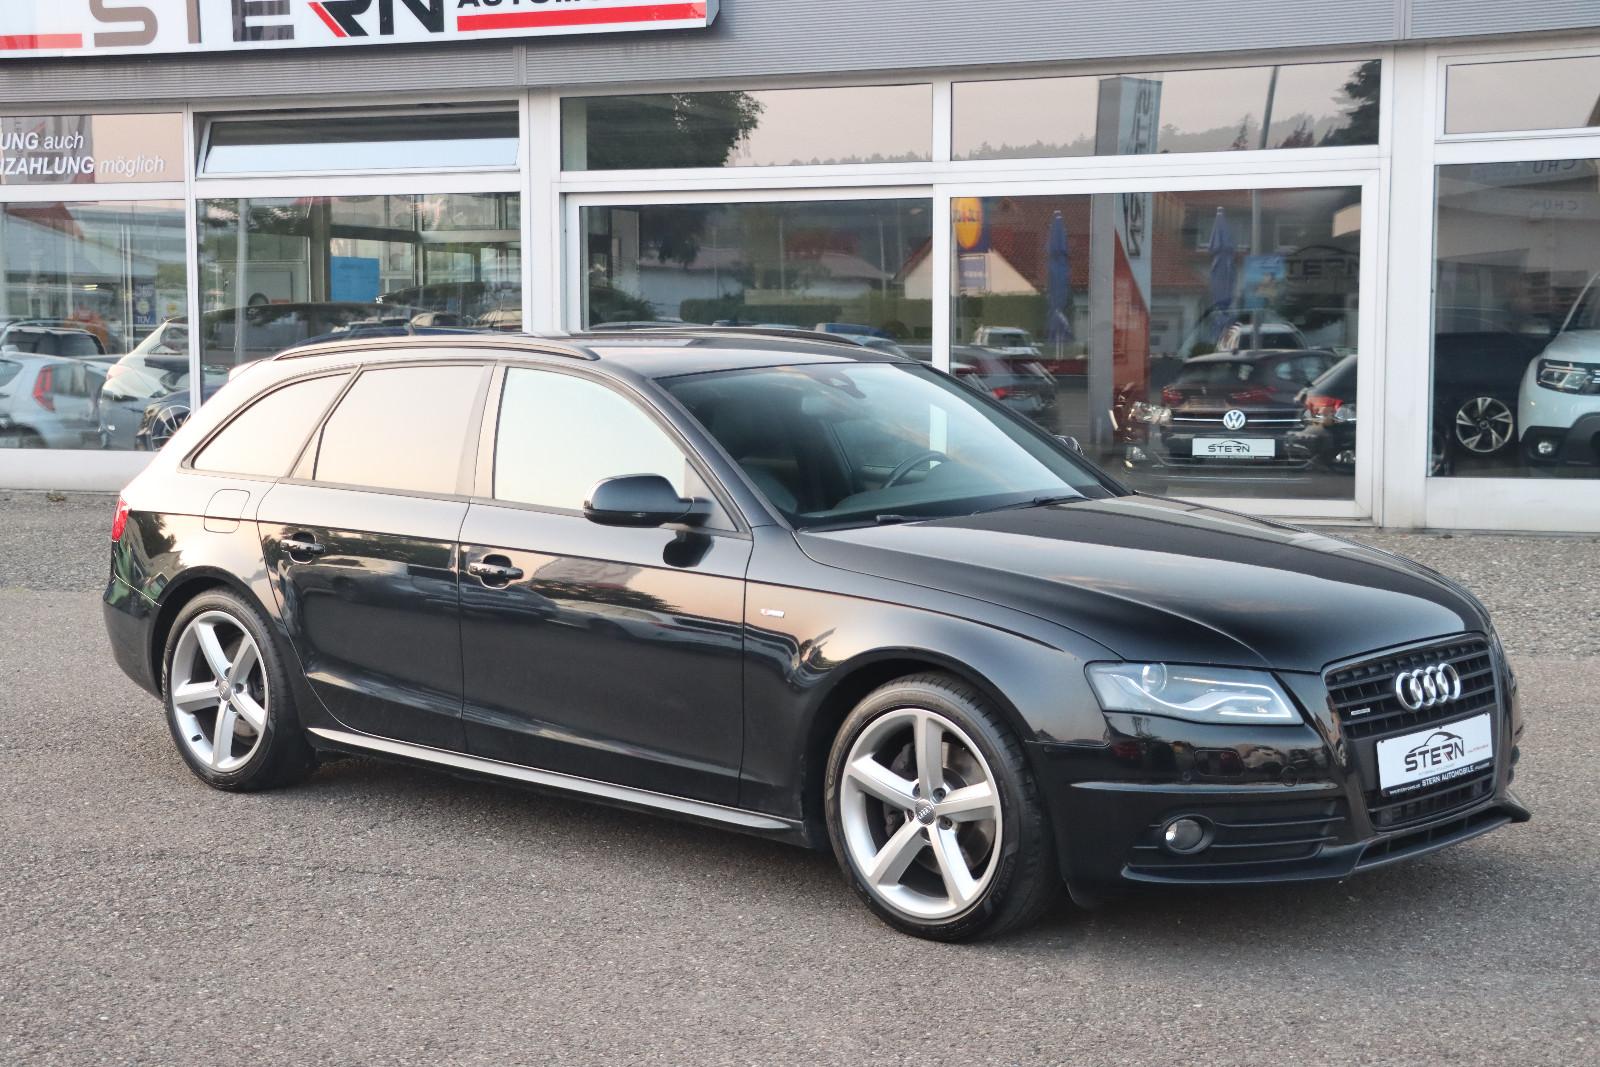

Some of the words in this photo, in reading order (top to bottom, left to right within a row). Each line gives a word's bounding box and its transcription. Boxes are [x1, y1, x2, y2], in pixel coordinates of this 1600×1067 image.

[43, 131, 84, 149] auch
[100, 154, 165, 178] möglich
[1207, 445, 1250, 453] STERN
[1404, 741, 1465, 773] STERN
